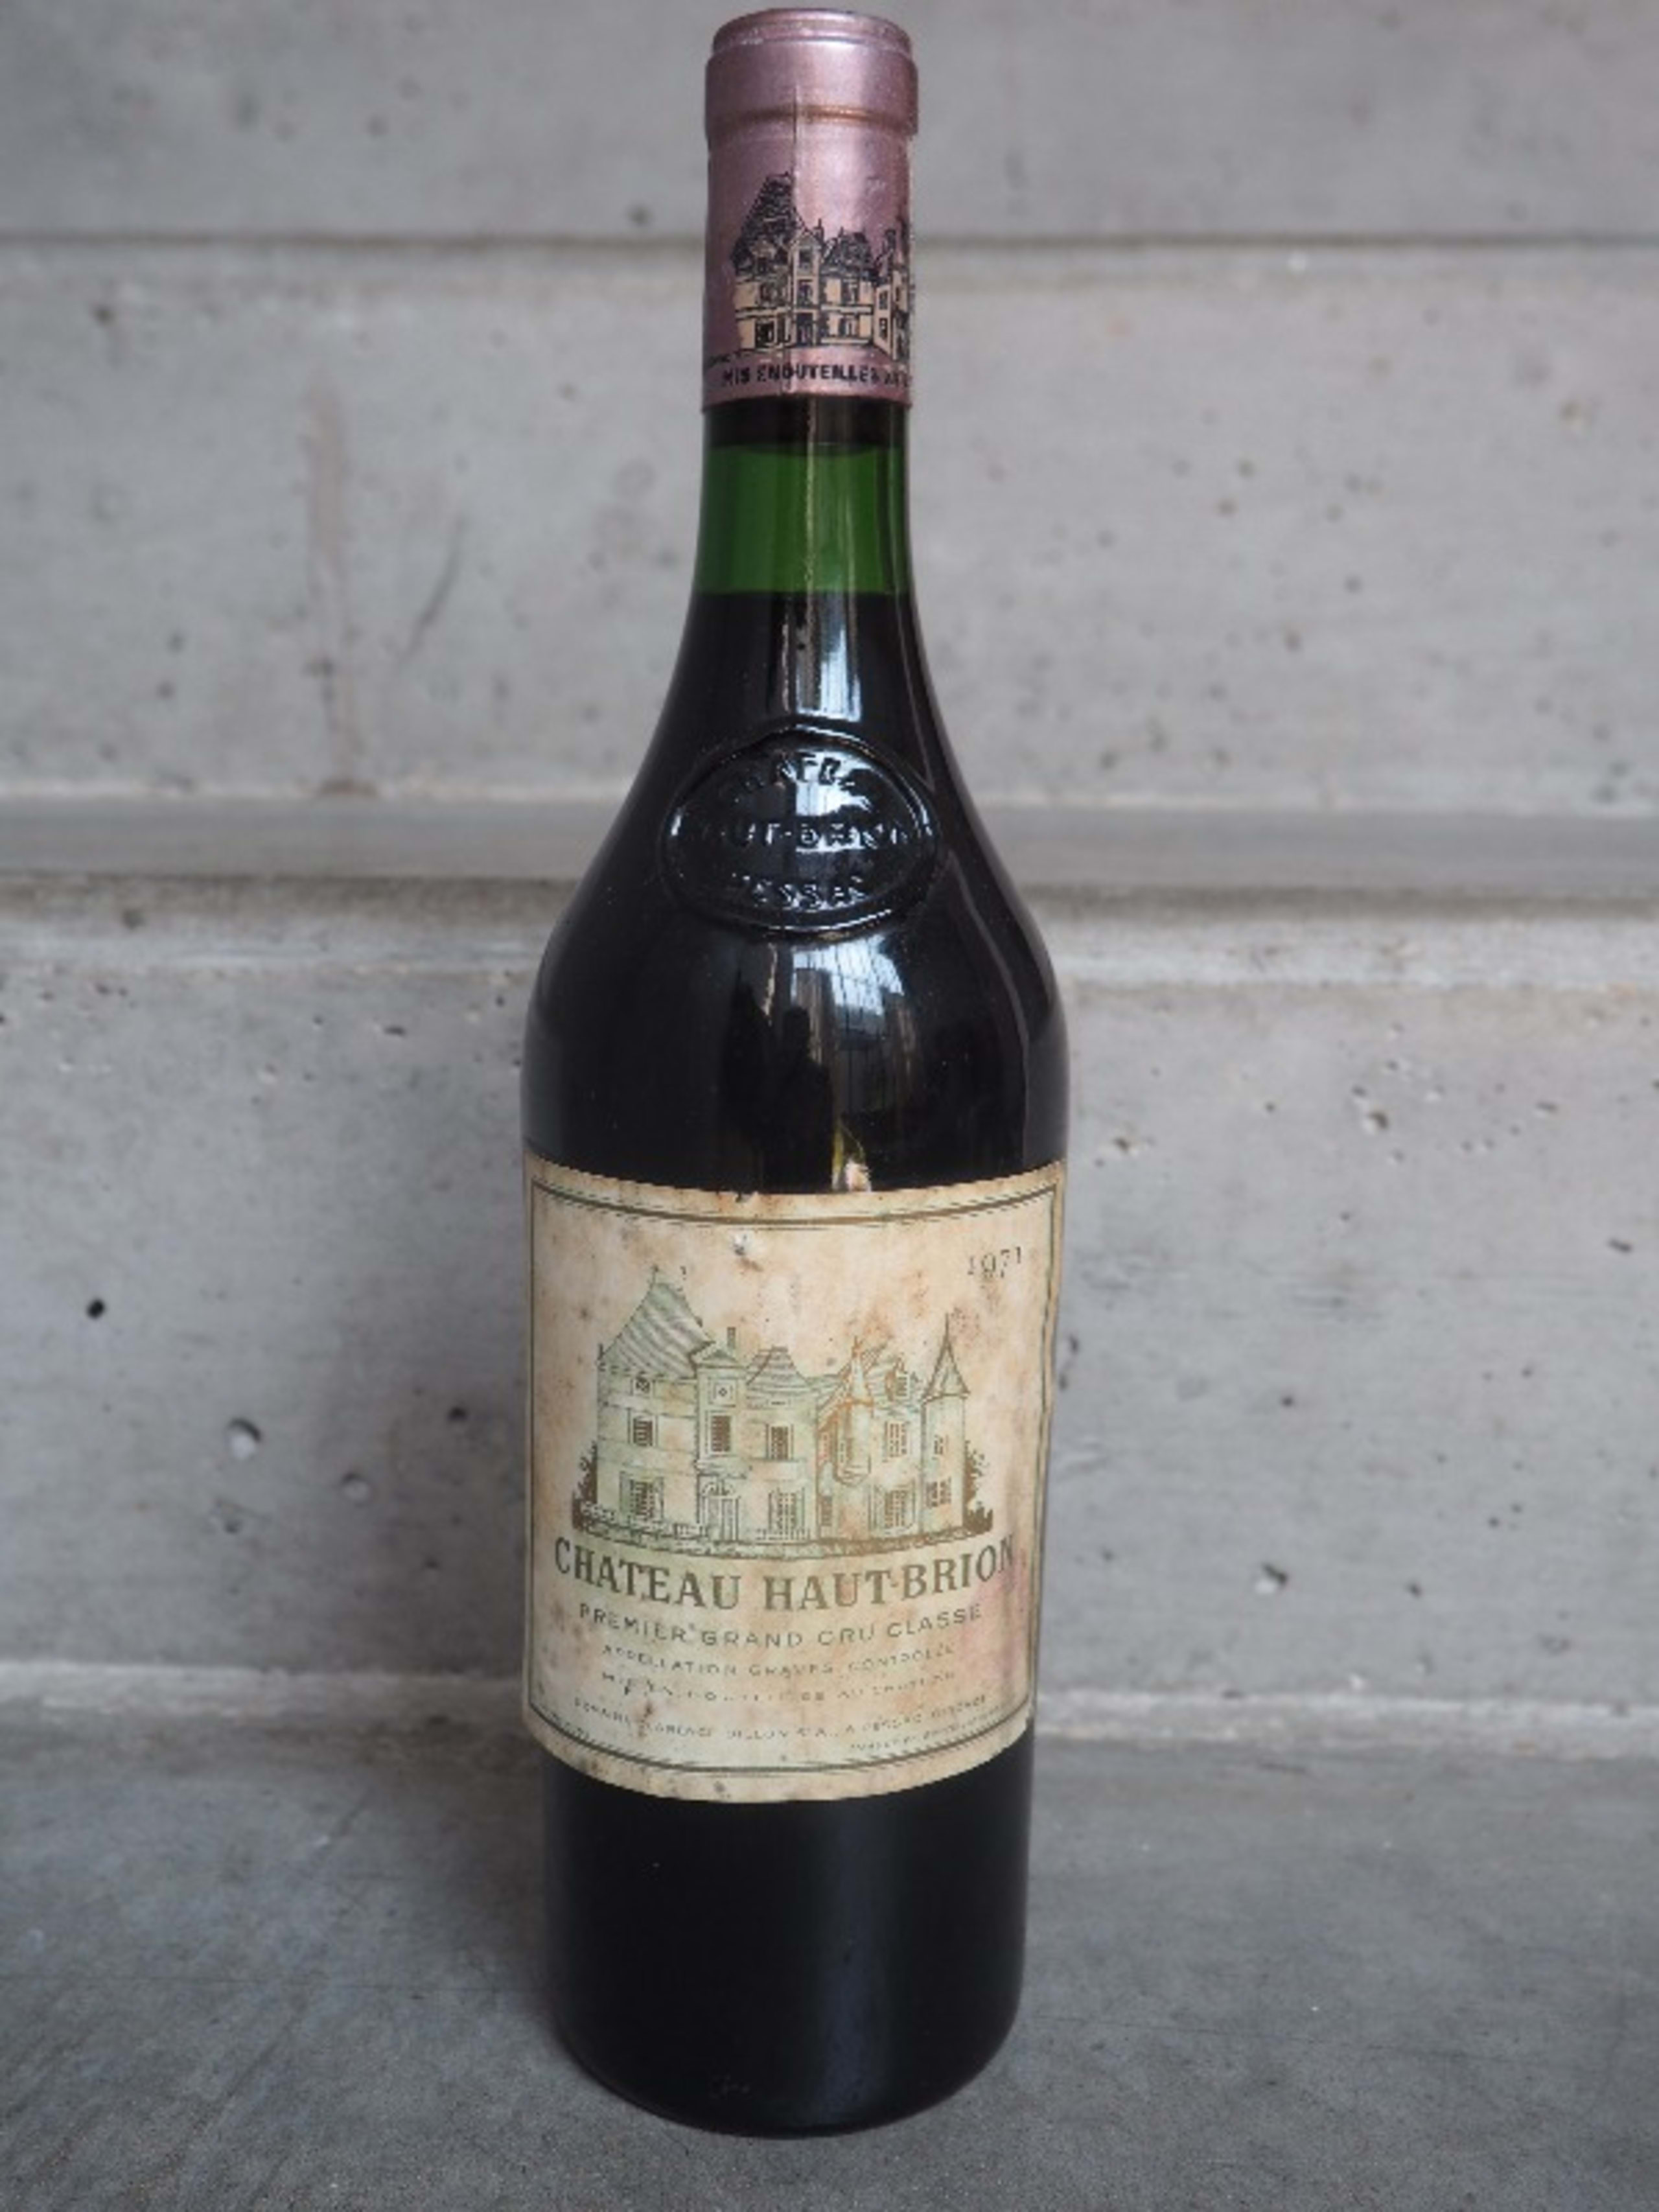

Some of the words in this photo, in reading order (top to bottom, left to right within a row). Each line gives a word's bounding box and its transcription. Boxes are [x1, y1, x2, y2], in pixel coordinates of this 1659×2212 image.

[555, 1535, 741, 1610] CHATEAU
[763, 1534, 1014, 1612] HAUT-BRION
[579, 1602, 687, 1642] PREMIER
[701, 1629, 804, 1649] GRAND
[817, 1627, 875, 1646] CRU
